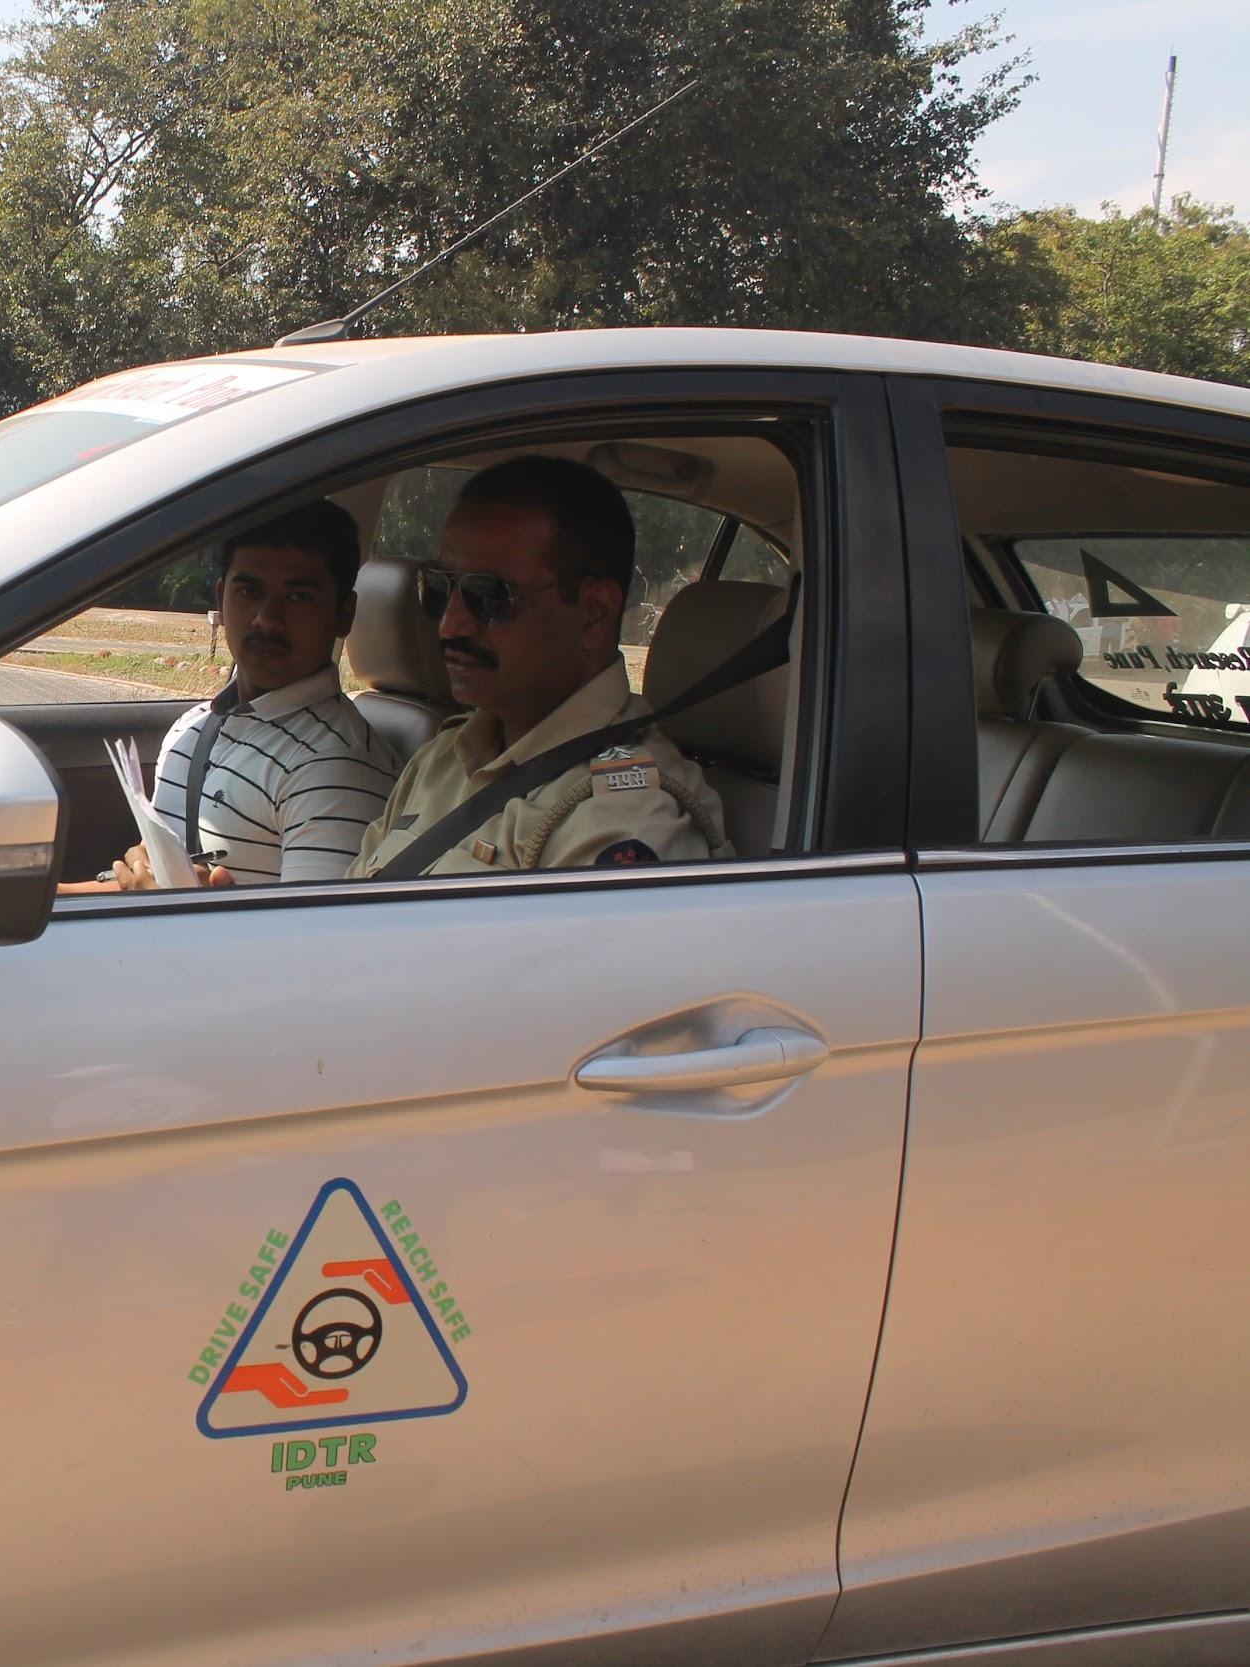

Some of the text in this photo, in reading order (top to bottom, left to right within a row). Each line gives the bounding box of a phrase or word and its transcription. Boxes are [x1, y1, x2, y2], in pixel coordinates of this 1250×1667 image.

[187, 1228, 289, 1387] DRIVE SAFE
[380, 1199, 472, 1344] REACH SAFE
[270, 1433, 378, 1473] IDTR
[286, 1470, 348, 1491] PUNE
